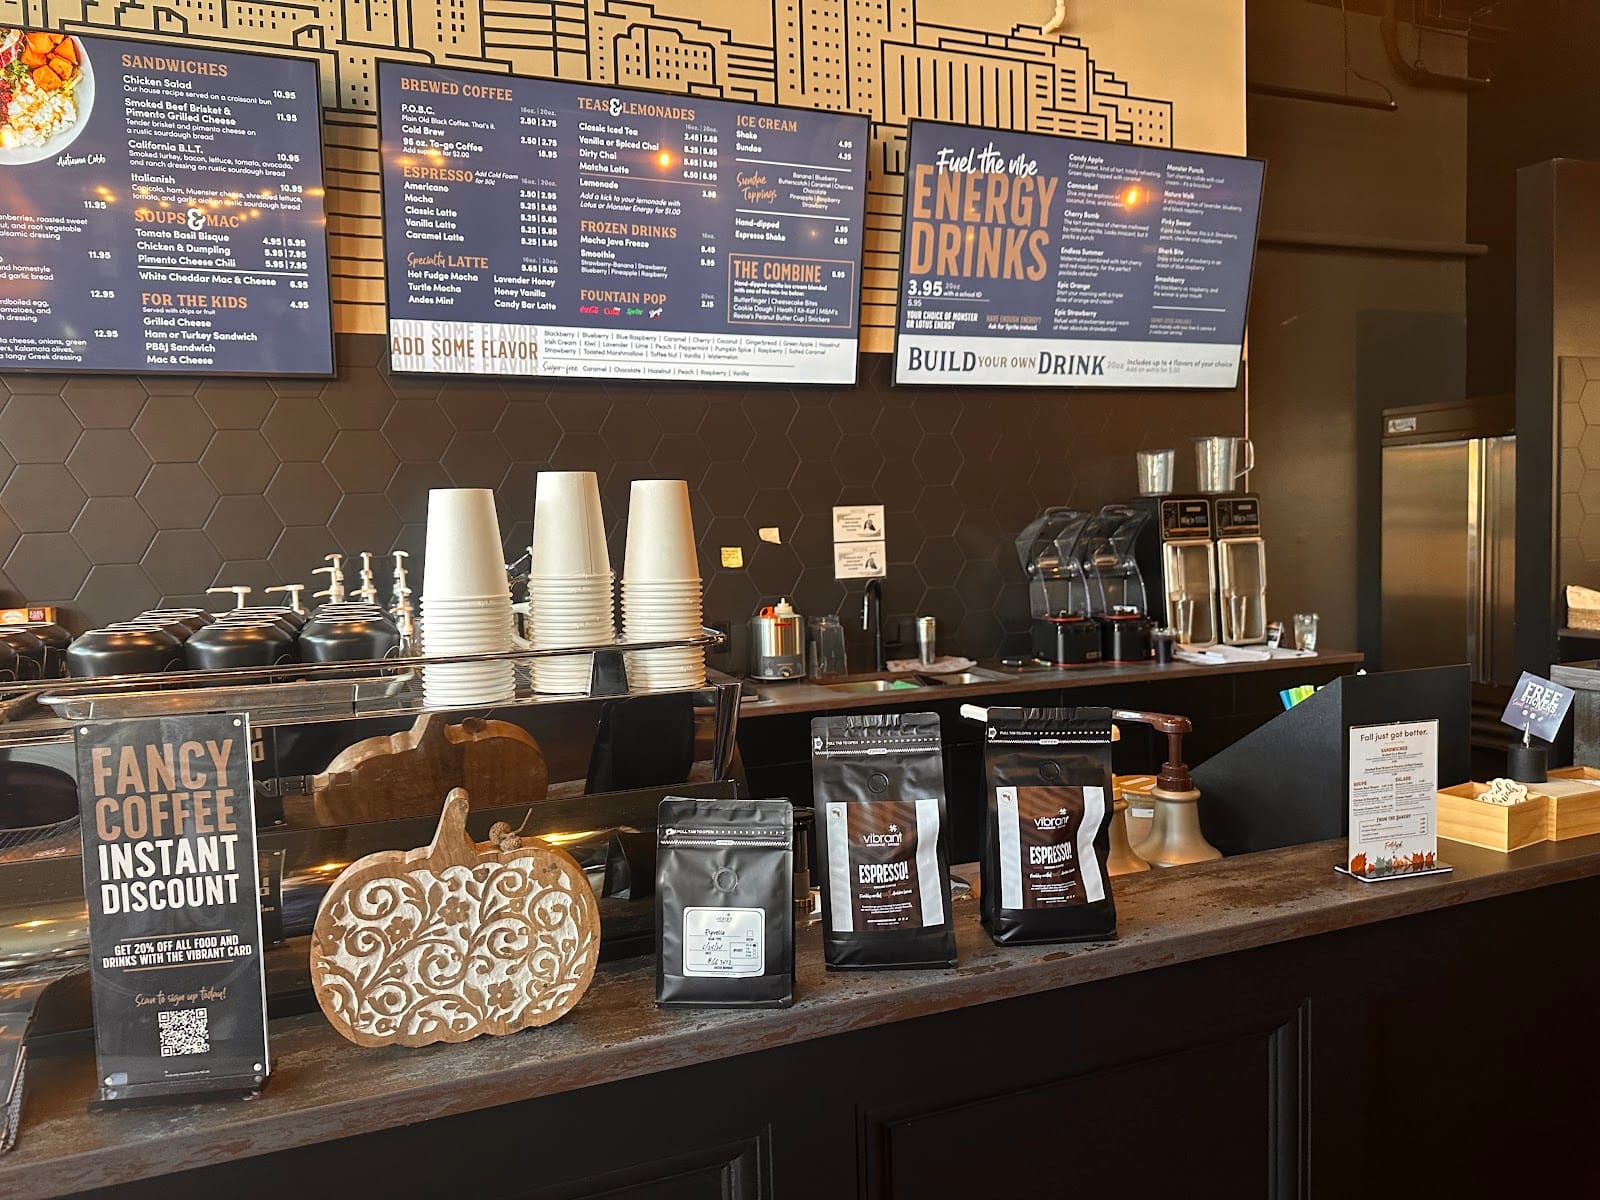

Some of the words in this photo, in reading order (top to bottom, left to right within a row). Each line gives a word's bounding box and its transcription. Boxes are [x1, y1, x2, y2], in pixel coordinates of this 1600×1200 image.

[121, 55, 227, 75] SANDWICHES
[123, 75, 162, 86] Chicken
[163, 79, 192, 89] Salad
[123, 84, 137, 92] Our
[139, 86, 160, 94] house
[161, 89, 184, 97] recipe
[227, 95, 257, 103] croissant
[258, 97, 272, 105] bun
[273, 90, 296, 99] 10.95
[401, 78, 459, 96] BREWED
[462, 84, 513, 101] COFFEE
[124, 98, 163, 109] Smoked
[165, 101, 187, 113] Beef
[189, 104, 221, 114] Brisket
[401, 104, 435, 114] P.O.B.C.
[578, 98, 608, 111] TEAS
[622, 104, 694, 119] LEMONADES
[125, 108, 165, 118] Pimento
[167, 112, 199, 122] Grilled
[201, 114, 236, 125] Cheese
[276, 113, 297, 121] 11.95
[737, 116, 754, 127] ICE
[758, 118, 797, 131] CREAM
[401, 125, 421, 134] Cold
[423, 127, 444, 136] Brew
[579, 123, 605, 132] Classic
[607, 125, 623, 134] Iced
[624, 127, 638, 135] Tea
[128, 139, 176, 151] California
[178, 143, 203, 153] B.L.T.
[403, 137, 414, 145] 96
[415, 139, 429, 147] oz.
[429, 139, 454, 150] To-go
[455, 142, 483, 151] Coffee
[277, 153, 299, 162] 10.95
[579, 148, 598, 159] Dirty
[599, 150, 616, 159] Chai
[936, 147, 976, 175] Fuel
[977, 142, 1005, 174] the
[1009, 153, 1038, 178] vibe
[403, 166, 473, 182] ESPRESSO
[579, 162, 608, 172] Matcha
[610, 165, 629, 173] Latte
[131, 173, 175, 183] Italianish
[579, 178, 618, 188] Lemonade
[403, 182, 449, 192] Americano
[404, 194, 433, 203] Mocha
[913, 164, 1058, 227] ENERGY
[135, 210, 185, 225] SOUPS
[206, 216, 240, 228] MAC
[405, 218, 433, 227] Vanilla
[435, 220, 456, 229] Latte
[135, 228, 171, 238] Tomato
[173, 230, 196, 239] Basil
[198, 231, 229, 242] Bisque
[405, 231, 441, 240] Caramel
[443, 233, 464, 241] Latte
[580, 221, 628, 234] FROZEN
[631, 224, 676, 237] DRINKS
[580, 235, 606, 244] Mocha
[606, 237, 623, 246] Java
[625, 238, 649, 247] Freeze
[136, 241, 175, 251] Chicken
[186, 244, 230, 256] Dumpling
[580, 249, 615, 258] Smoothie
[908, 222, 1049, 282] DRINKS
[448, 255, 488, 269] LATTE
[138, 271, 167, 280] White
[168, 273, 210, 282] Cheddar
[211, 275, 232, 283] Mac
[243, 276, 276, 285] Cheese
[407, 270, 422, 278] Hot
[423, 271, 449, 281] Fudge
[450, 272, 478, 281] Mocha
[734, 261, 757, 278] THE
[763, 263, 820, 281] COMBINE
[407, 283, 432, 291] Turtle
[433, 284, 461, 292] Mocha
[493, 275, 530, 284] Lavender
[531, 277, 555, 287] Honey
[907, 280, 943, 296] 3.95
[142, 293, 172, 305] FOR
[178, 294, 206, 307] THE
[211, 296, 247, 308] KIDS
[580, 290, 640, 302] FOUNTAIN
[642, 293, 666, 304] POP
[494, 299, 520, 309] Candy
[521, 300, 535, 309] Bar
[536, 301, 556, 310] Latte
[143, 317, 175, 326] Grilled
[176, 318, 211, 327] Cheese
[144, 329, 167, 338] Ham
[180, 330, 211, 341] Turkey
[213, 332, 257, 340] Sandwich
[145, 342, 168, 352] PB&J
[170, 343, 215, 352] Sandwich
[390, 338, 424, 355] ADD
[431, 339, 472, 356] SOME
[481, 341, 537, 359] FLAVOR
[908, 347, 976, 372] BUILD
[978, 356, 1008, 368] YOUR
[1011, 357, 1036, 369] OWN
[1038, 351, 1106, 376] DRINK
[1525, 681, 1563, 706] FREE
[1520, 695, 1557, 714] STICKERS
[1375, 733, 1389, 742] just
[1391, 732, 1403, 740] got
[91, 738, 233, 796] FANCY
[95, 789, 237, 841] COFFEE
[863, 832, 902, 843] vibrant
[98, 834, 238, 881] INSTANT
[1030, 841, 1072, 864] ESPRESSO!
[859, 861, 909, 884] ESPRESSO!
[101, 874, 240, 915] DISCOUNT
[114, 944, 131, 955] GET
[134, 942, 154, 954] 20%
[156, 940, 173, 952] OFF
[175, 939, 191, 950] ALL
[194, 937, 217, 948] FOOD
[220, 935, 238, 947] AND
[102, 955, 137, 968] DRINKS
[139, 953, 163, 964] WITH
[166, 950, 183, 962] THE
[185, 947, 224, 960] VIBRANT
[227, 944, 251, 956] CARD
[157, 990, 166, 1005] to
